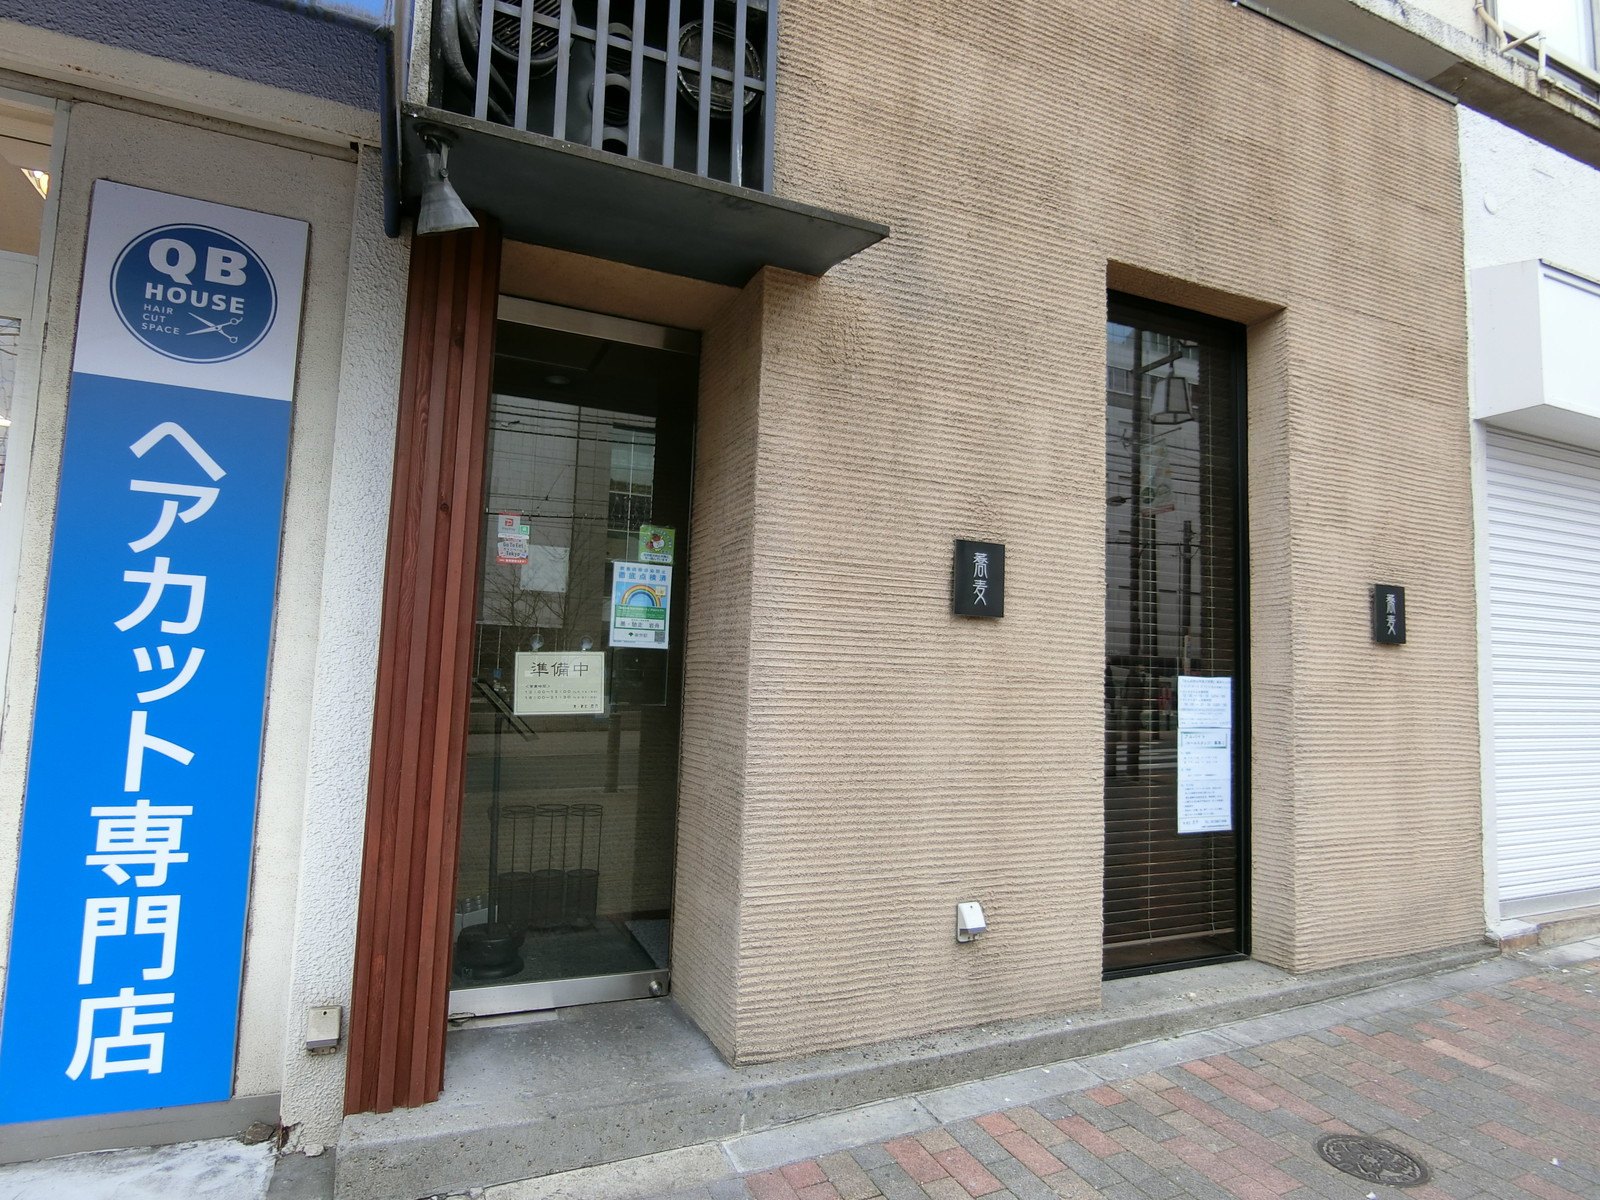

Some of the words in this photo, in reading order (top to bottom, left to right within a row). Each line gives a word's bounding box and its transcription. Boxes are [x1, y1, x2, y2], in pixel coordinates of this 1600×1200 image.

[148, 238, 248, 286] QB
[143, 303, 174, 315] HAIR
[145, 282, 245, 314] HOUSE
[141, 322, 180, 335] SPACE
[142, 313, 167, 323] CUT
[973, 552, 988, 606] 蕎麦
[1385, 593, 1396, 636] 蕎麦
[530, 661, 589, 677] 準備中
[65, 421, 227, 1081] ヘアカット専門店
